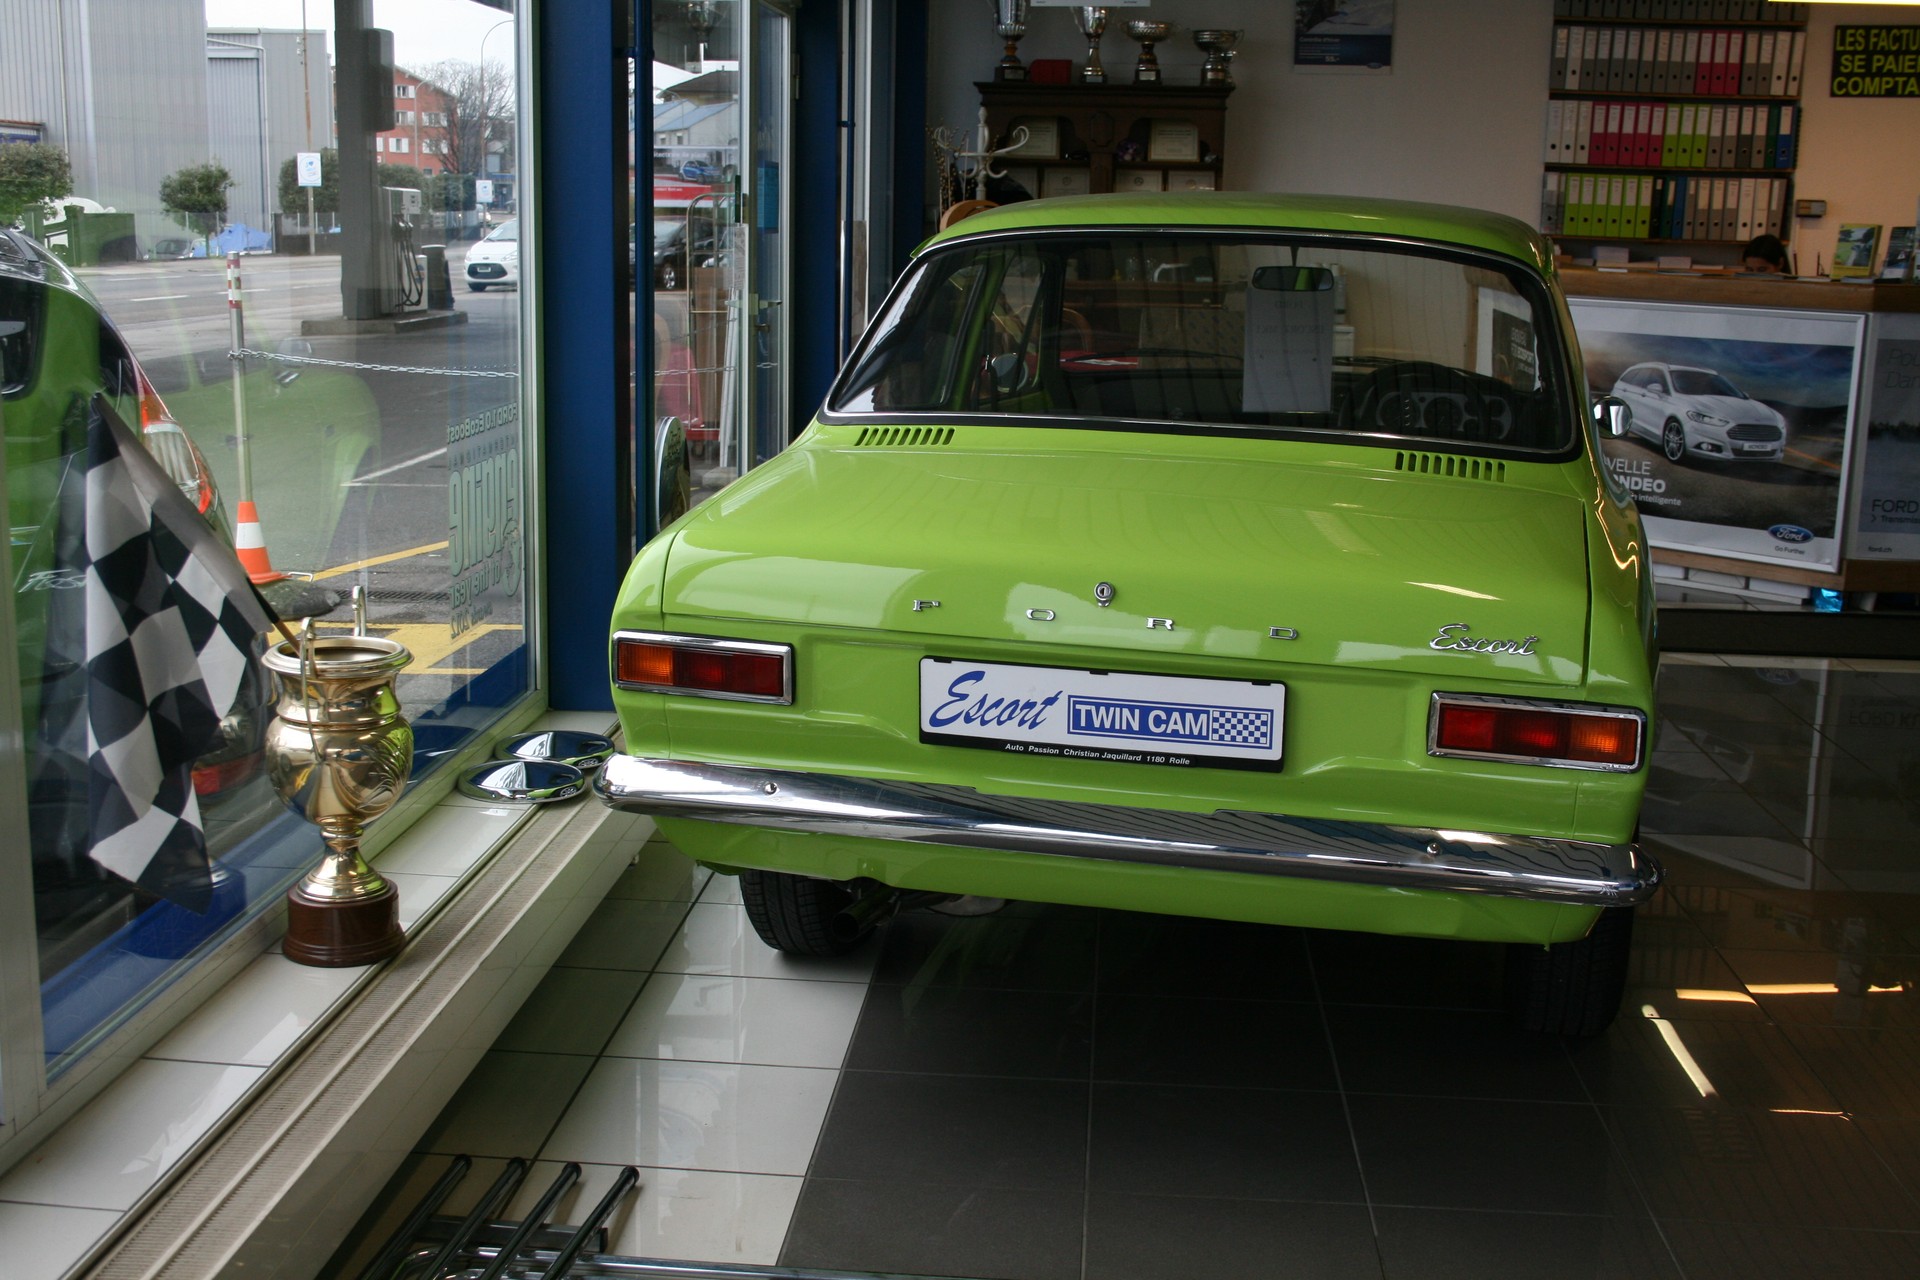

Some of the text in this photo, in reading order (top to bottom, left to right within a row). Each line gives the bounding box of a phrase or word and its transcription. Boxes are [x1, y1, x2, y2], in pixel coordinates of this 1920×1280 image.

[1836, 29, 1866, 51] LES
[1839, 54, 1866, 73] SE
[1832, 76, 1920, 95] COMPTA
[1613, 474, 1666, 493] NDEO
[1638, 494, 1682, 506] intelligente
[1871, 498, 1919, 513] FORD
[1777, 527, 1804, 541] Ford
[1784, 546, 1805, 555] Further
[1429, 622, 1539, 656] Escort
[928, 669, 1208, 737] Escort TWIN CAM
[1005, 743, 1190, 766] Auto Passion Christian Jaquillard 1180 Rolle
